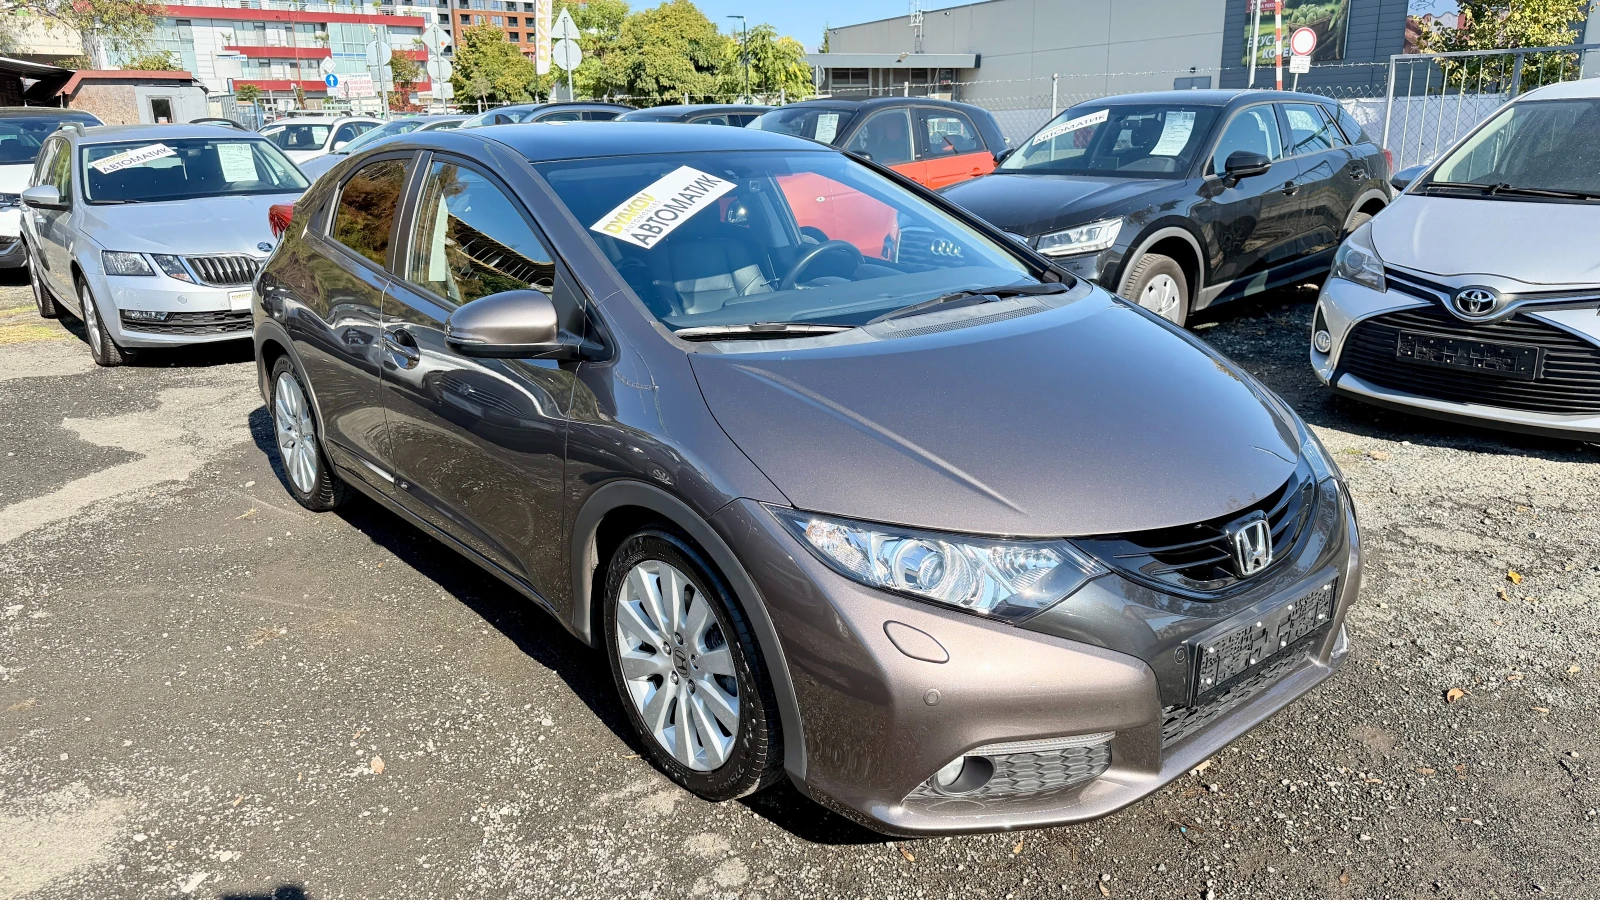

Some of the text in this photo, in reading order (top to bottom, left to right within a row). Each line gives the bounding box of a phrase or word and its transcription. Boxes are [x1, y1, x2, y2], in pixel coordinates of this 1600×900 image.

[1034, 114, 1106, 144] АВТОМАТИК
[103, 147, 171, 173] АВТОМАТИК
[603, 192, 656, 234] DYAKOV
[625, 200, 662, 232] AUTOMOBILES
[631, 174, 722, 246] АВТОМАТИК
